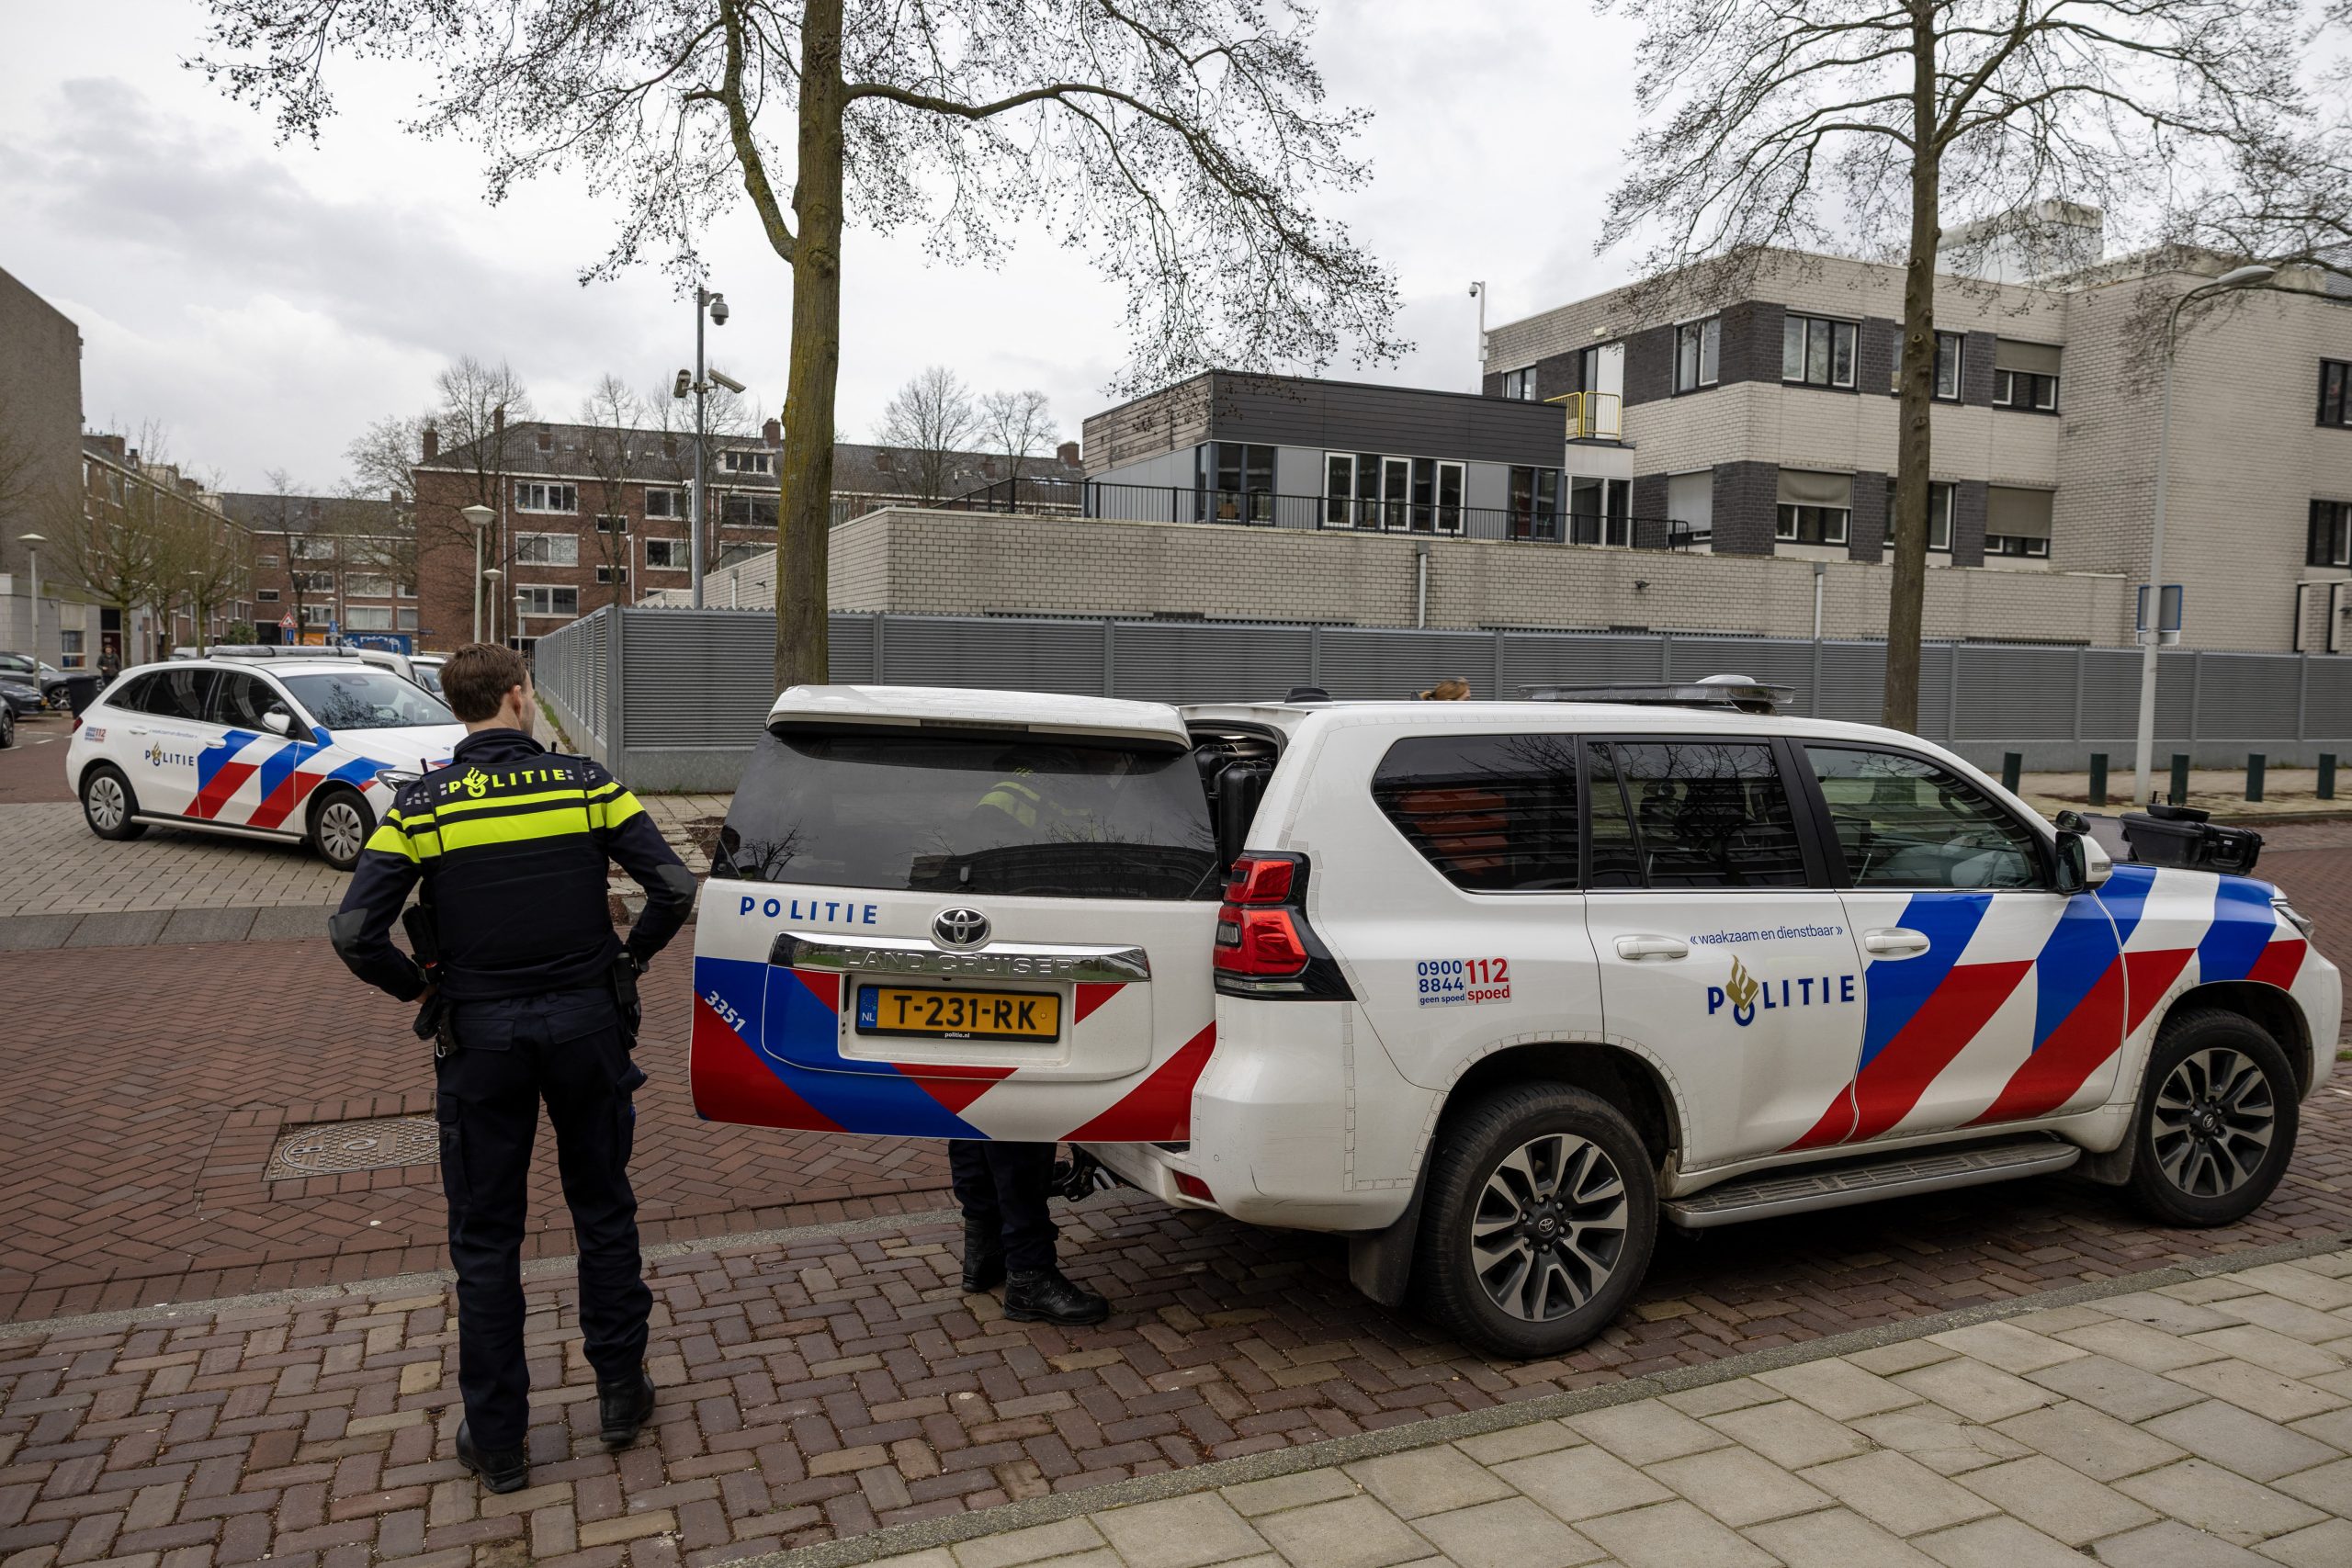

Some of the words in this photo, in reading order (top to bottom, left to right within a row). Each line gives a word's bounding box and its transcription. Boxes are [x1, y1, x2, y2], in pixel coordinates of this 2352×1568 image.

[145, 750, 194, 766] POLITIE
[448, 770, 566, 797] POLITIE
[740, 896, 877, 924] POLITIE
[1699, 930, 1759, 944] waakzaam
[1761, 931, 1775, 941] en
[1777, 924, 1834, 939] dienstbaar
[844, 950, 926, 969] LAND
[938, 954, 1074, 975] CRUISER
[1418, 960, 1463, 976] 0900
[1465, 958, 1509, 984] 112
[1419, 977, 1464, 992] 8844
[1467, 985, 1510, 1003] spoed
[1420, 996, 1440, 1005] geen
[1442, 994, 1465, 1004] spoed
[1707, 975, 1855, 1027] POLITIE
[705, 990, 746, 1032] 3351
[862, 1012, 875, 1021] NL
[894, 995, 1036, 1030] T-231-RK
